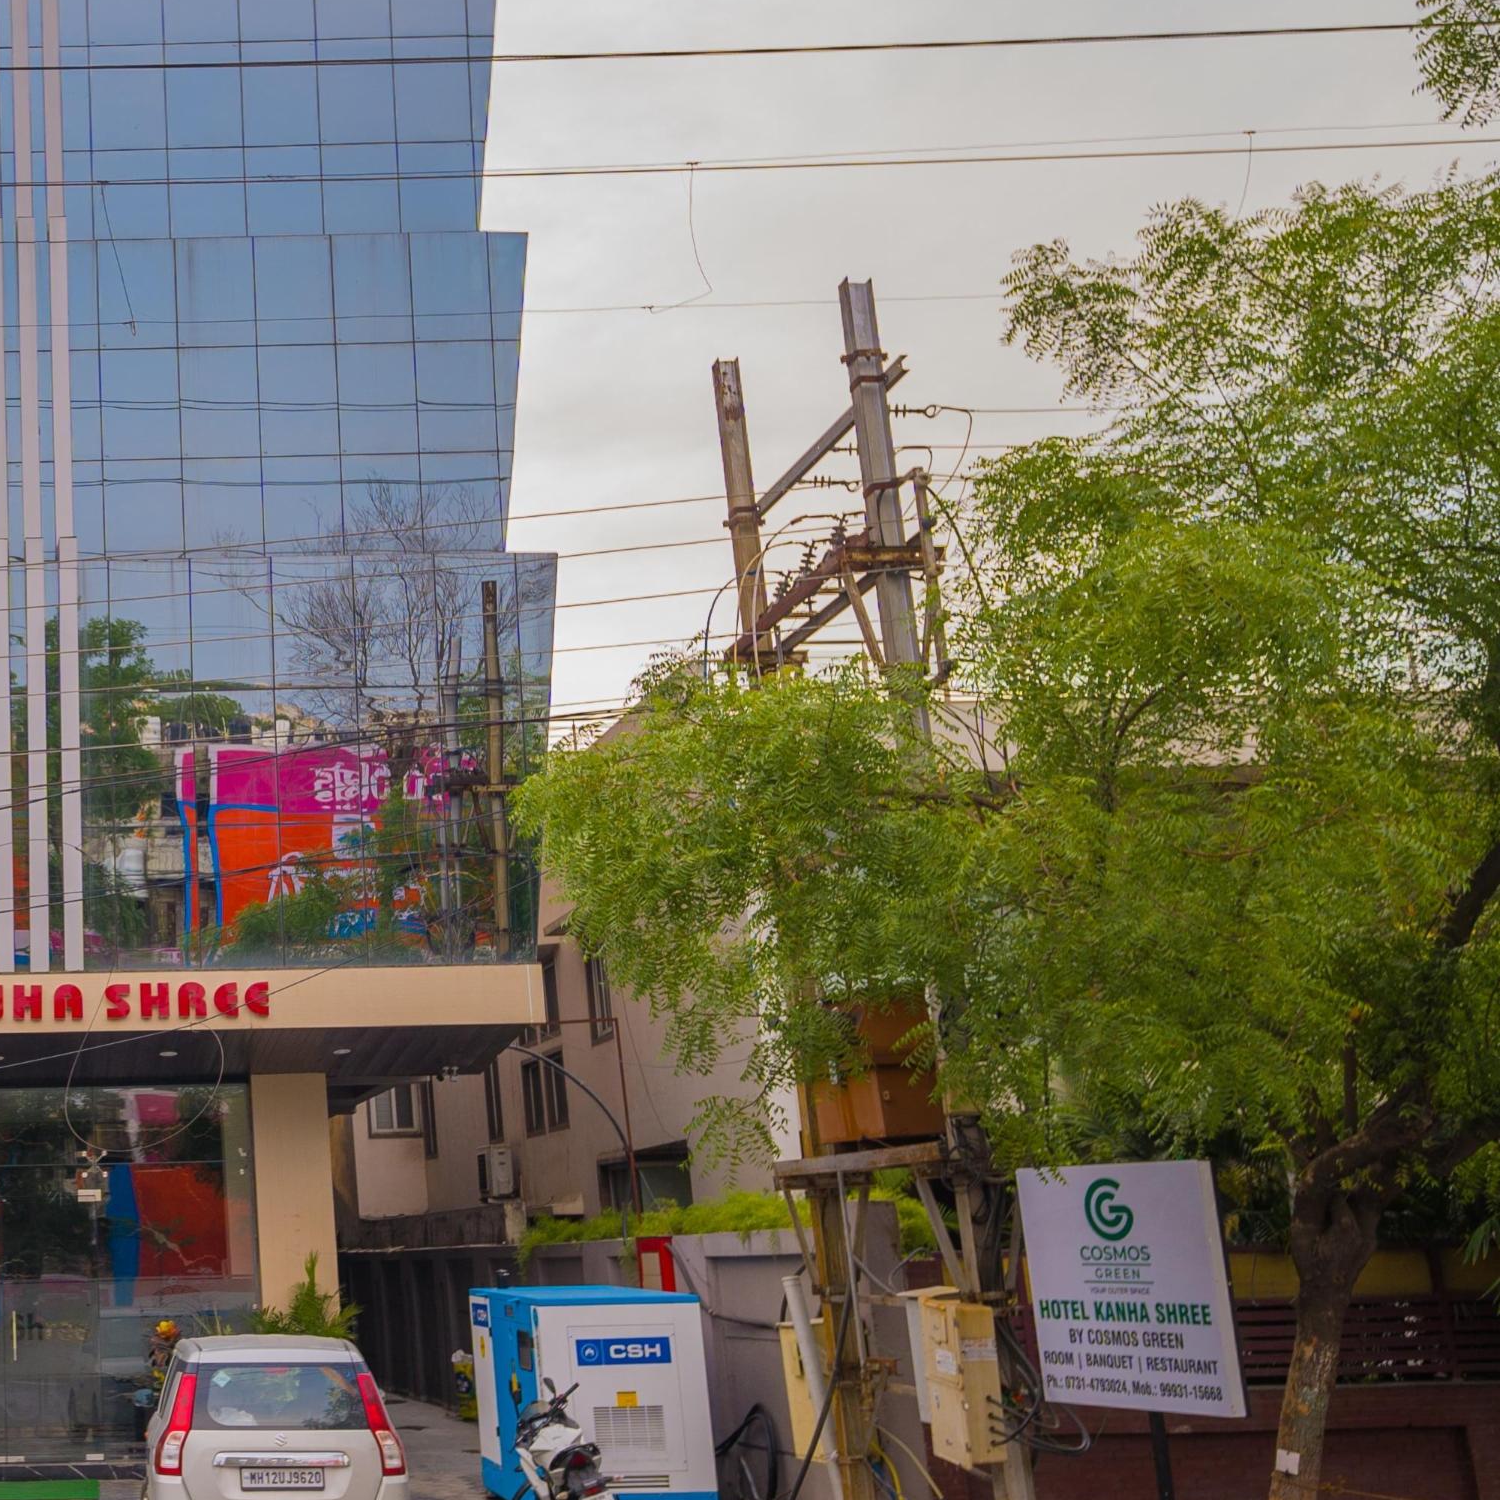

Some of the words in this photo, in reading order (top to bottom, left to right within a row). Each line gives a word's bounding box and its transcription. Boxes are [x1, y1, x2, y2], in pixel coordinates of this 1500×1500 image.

[104, 981, 271, 1021] SHREE
[1080, 1245, 1151, 1261] COSMOS
[1094, 1267, 1141, 1279] GREEN
[1039, 1299, 1090, 1320] HOTEL
[1094, 1301, 1151, 1323] KANHA
[1155, 1303, 1212, 1326] SHREE
[1069, 1328, 1083, 1344] BY
[1087, 1329, 1139, 1347] COSMOS
[1142, 1331, 1184, 1350] GREEN
[609, 1343, 662, 1359] CSH
[1044, 1351, 1074, 1366] ROOM
[1086, 1353, 1133, 1370] BANQUET
[1146, 1356, 1218, 1376] RESTAURANT
[249, 1471, 322, 1485] MH12UJ9620
